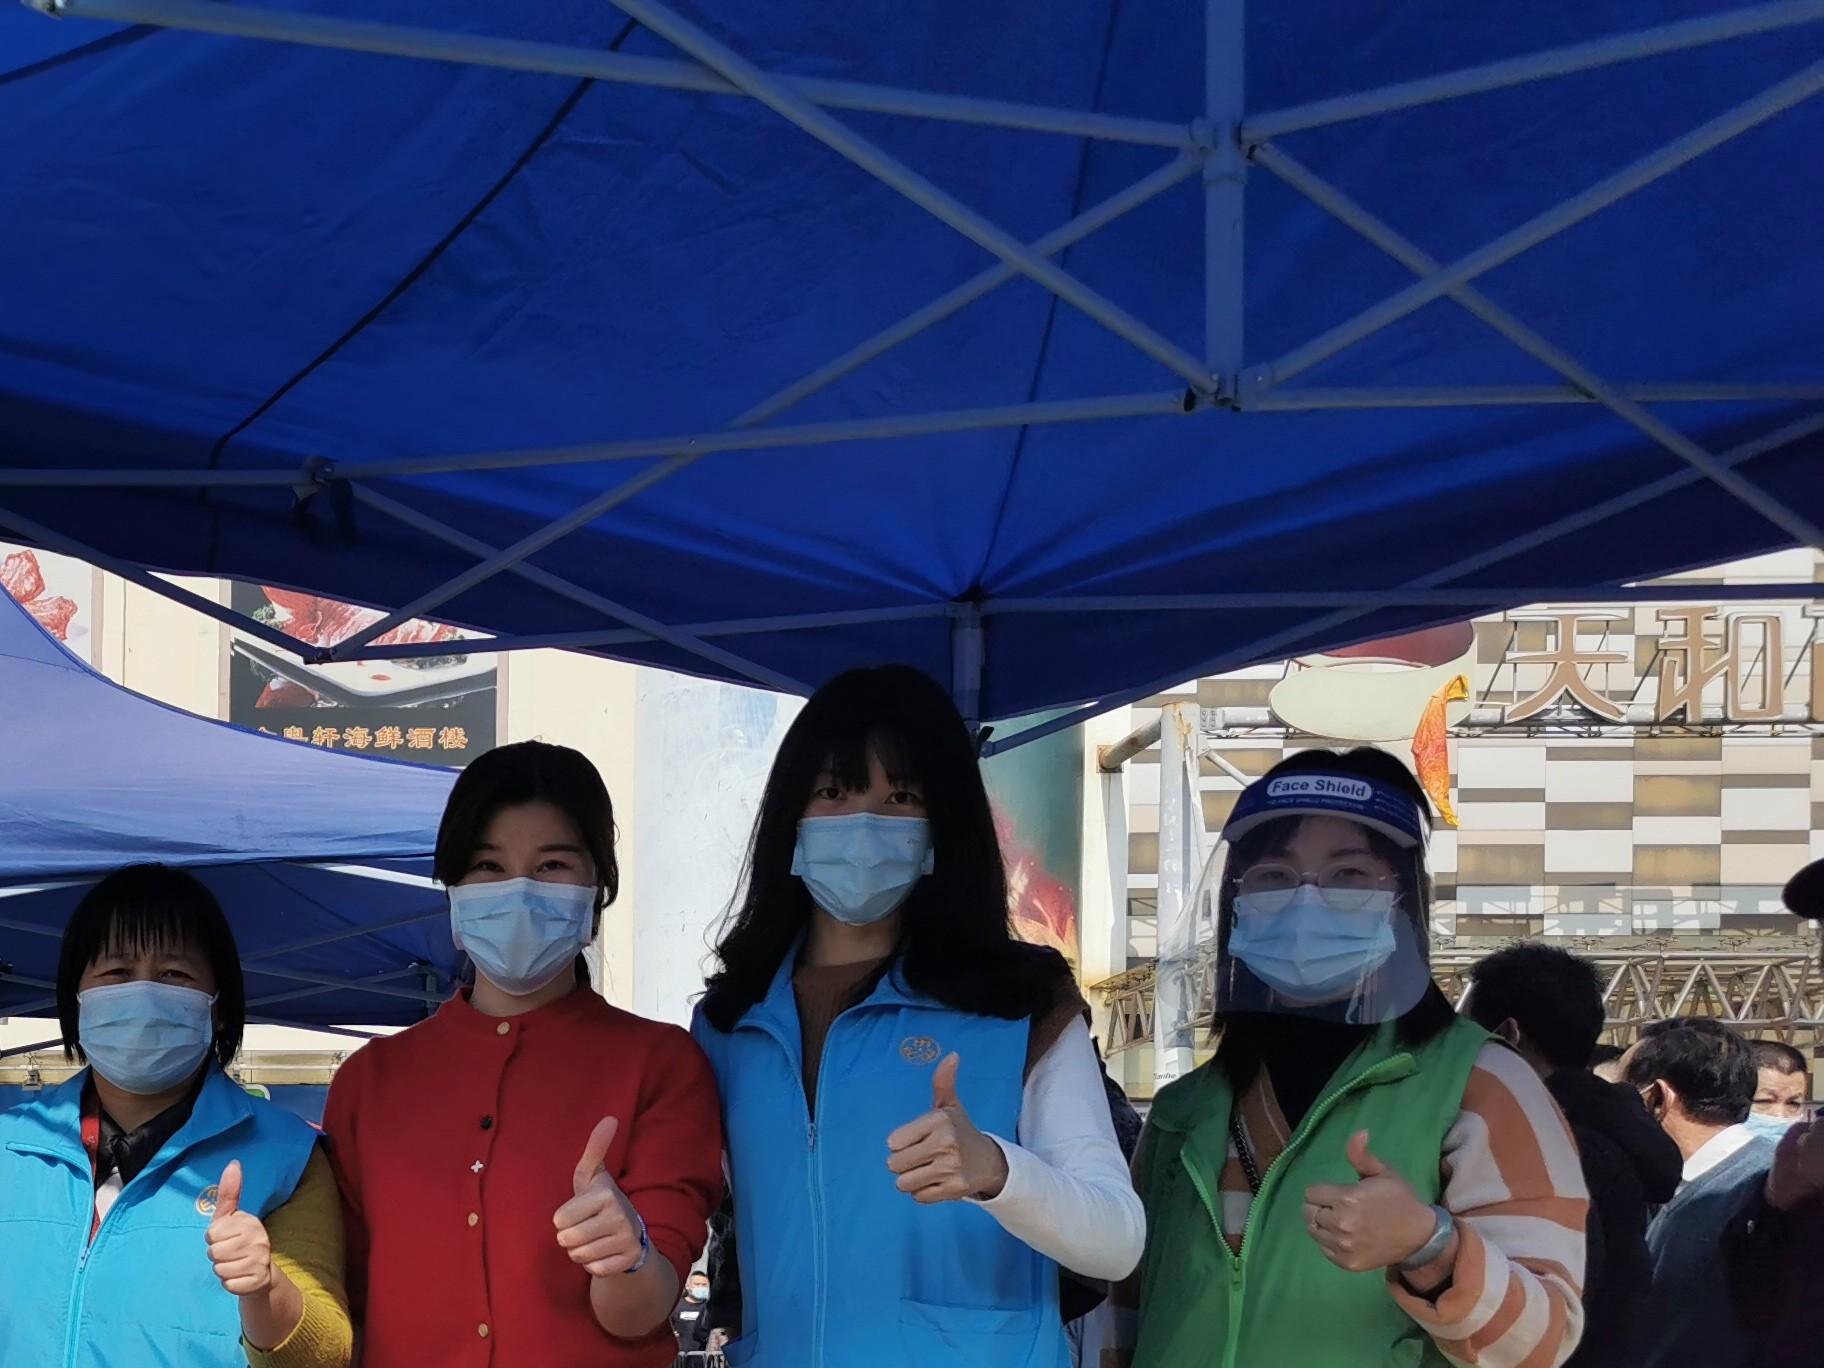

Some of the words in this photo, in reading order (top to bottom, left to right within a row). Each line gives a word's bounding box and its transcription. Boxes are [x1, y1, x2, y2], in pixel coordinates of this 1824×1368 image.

[1505, 606, 1824, 723] 天和
[258, 725, 469, 750] 粤轩海鲜酒楼
[1272, 780, 1310, 793] Face
[1314, 779, 1366, 798] Shield
